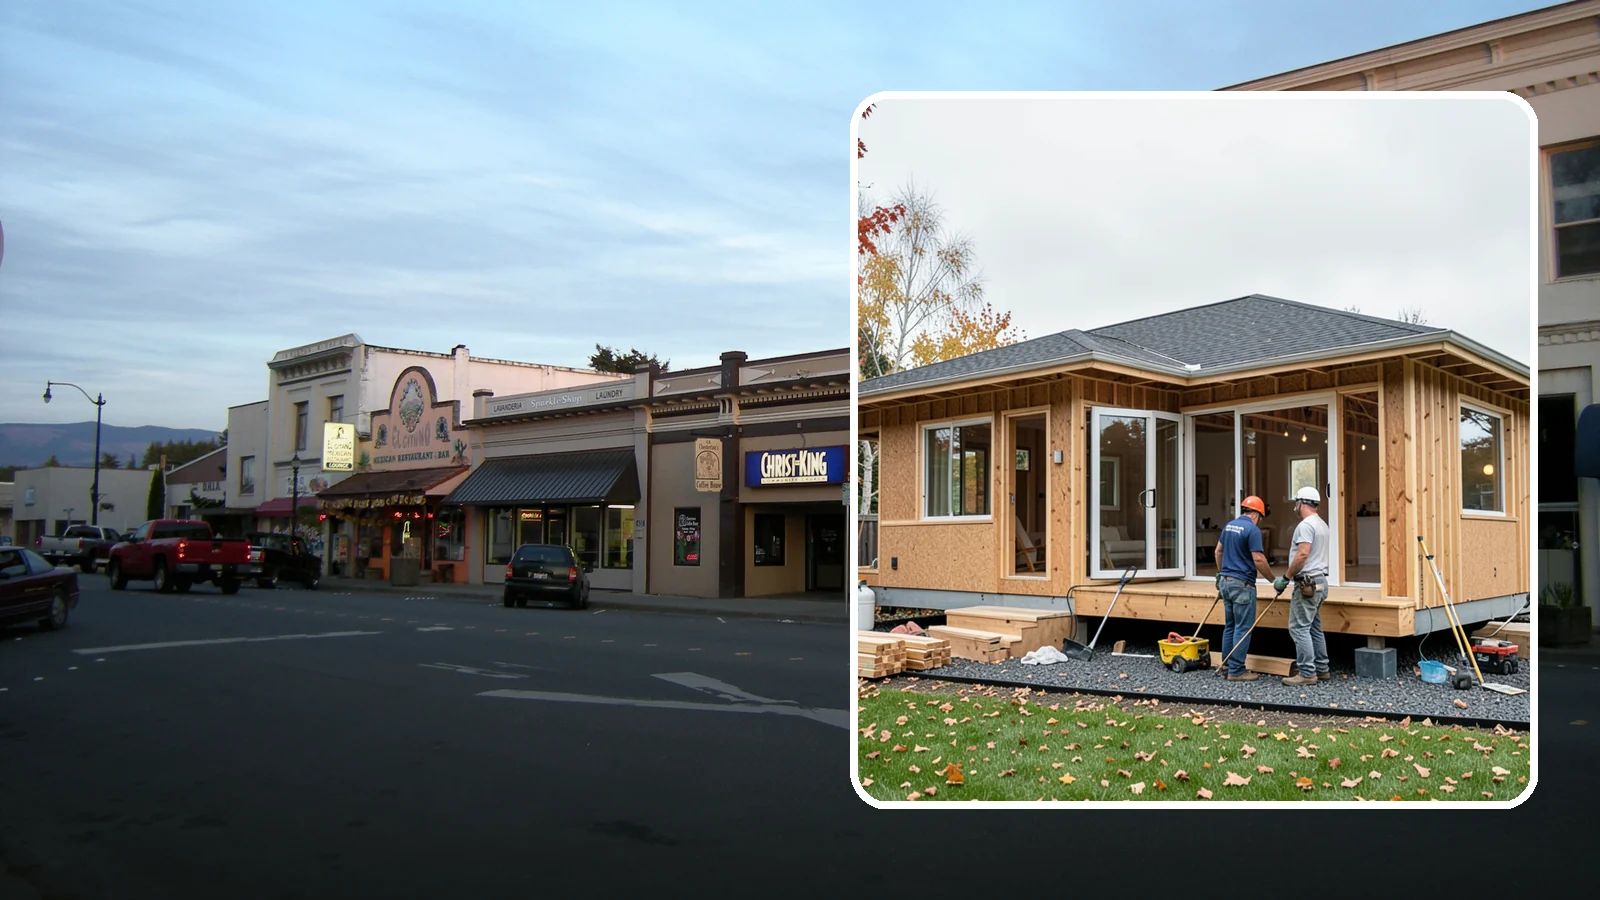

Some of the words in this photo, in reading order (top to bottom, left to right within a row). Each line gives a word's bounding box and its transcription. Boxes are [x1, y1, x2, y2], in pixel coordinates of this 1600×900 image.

[493, 402, 523, 412] LAVANDERIA
[531, 398, 560, 409] Sparkle
[562, 395, 582, 404] Shop
[595, 389, 623, 400] LAUNDRY
[373, 454, 396, 464] MEXICAN
[397, 451, 434, 462] RESTAURANT
[438, 450, 450, 459] BAR
